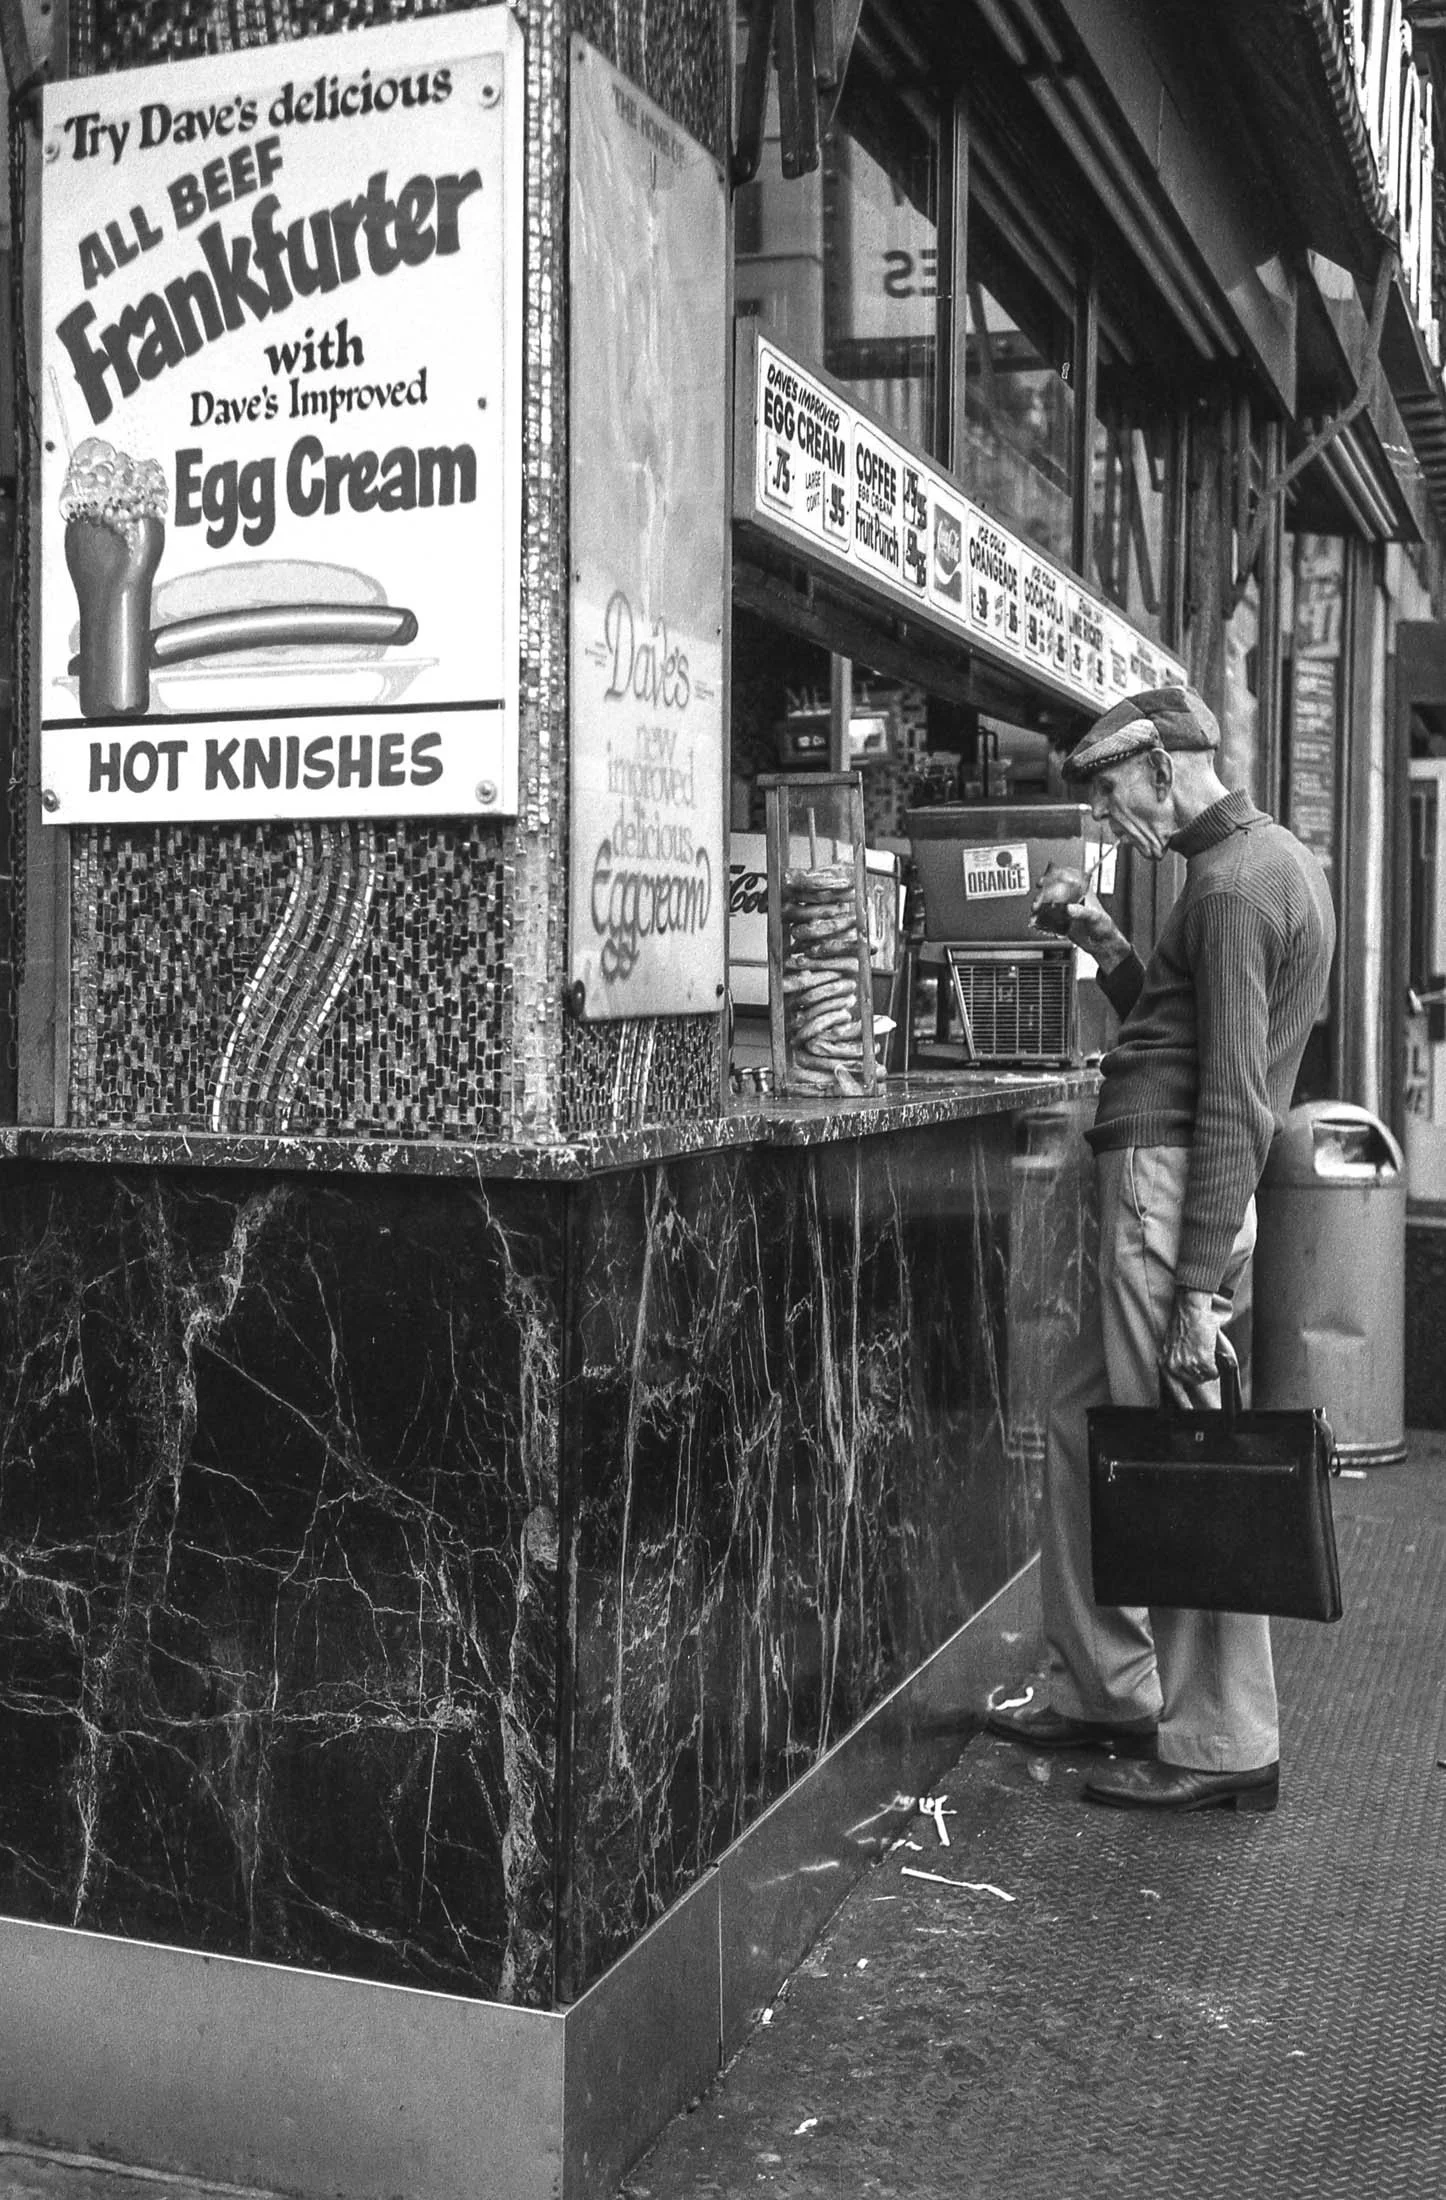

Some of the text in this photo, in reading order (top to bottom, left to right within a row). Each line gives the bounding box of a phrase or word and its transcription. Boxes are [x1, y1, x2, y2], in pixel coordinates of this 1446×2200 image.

[63, 68, 453, 165] Try Dave's delicious
[79, 136, 284, 290] ALL BEEF
[55, 169, 483, 425] Frankfurter
[264, 319, 365, 375] with
[190, 368, 428, 428] Dave's Improved
[767, 364, 840, 433] DAVE'S IMPROVED
[764, 386, 846, 479] EGG CREAM
[174, 435, 477, 549] Egg Cream
[856, 442, 896, 506] COFFEE
[858, 482, 870, 504] EGG
[871, 491, 893, 517] CREAM
[856, 500, 875, 551] Fruit
[875, 512, 899, 568] Punch
[969, 536, 1018, 598] ORANGEADE
[604, 590, 690, 710] Dave's
[89, 732, 444, 794] HOT KNISHES
[607, 740, 697, 809] improved
[636, 724, 677, 763] new
[613, 797, 694, 865] delicious
[968, 866, 1027, 894] ORANGE
